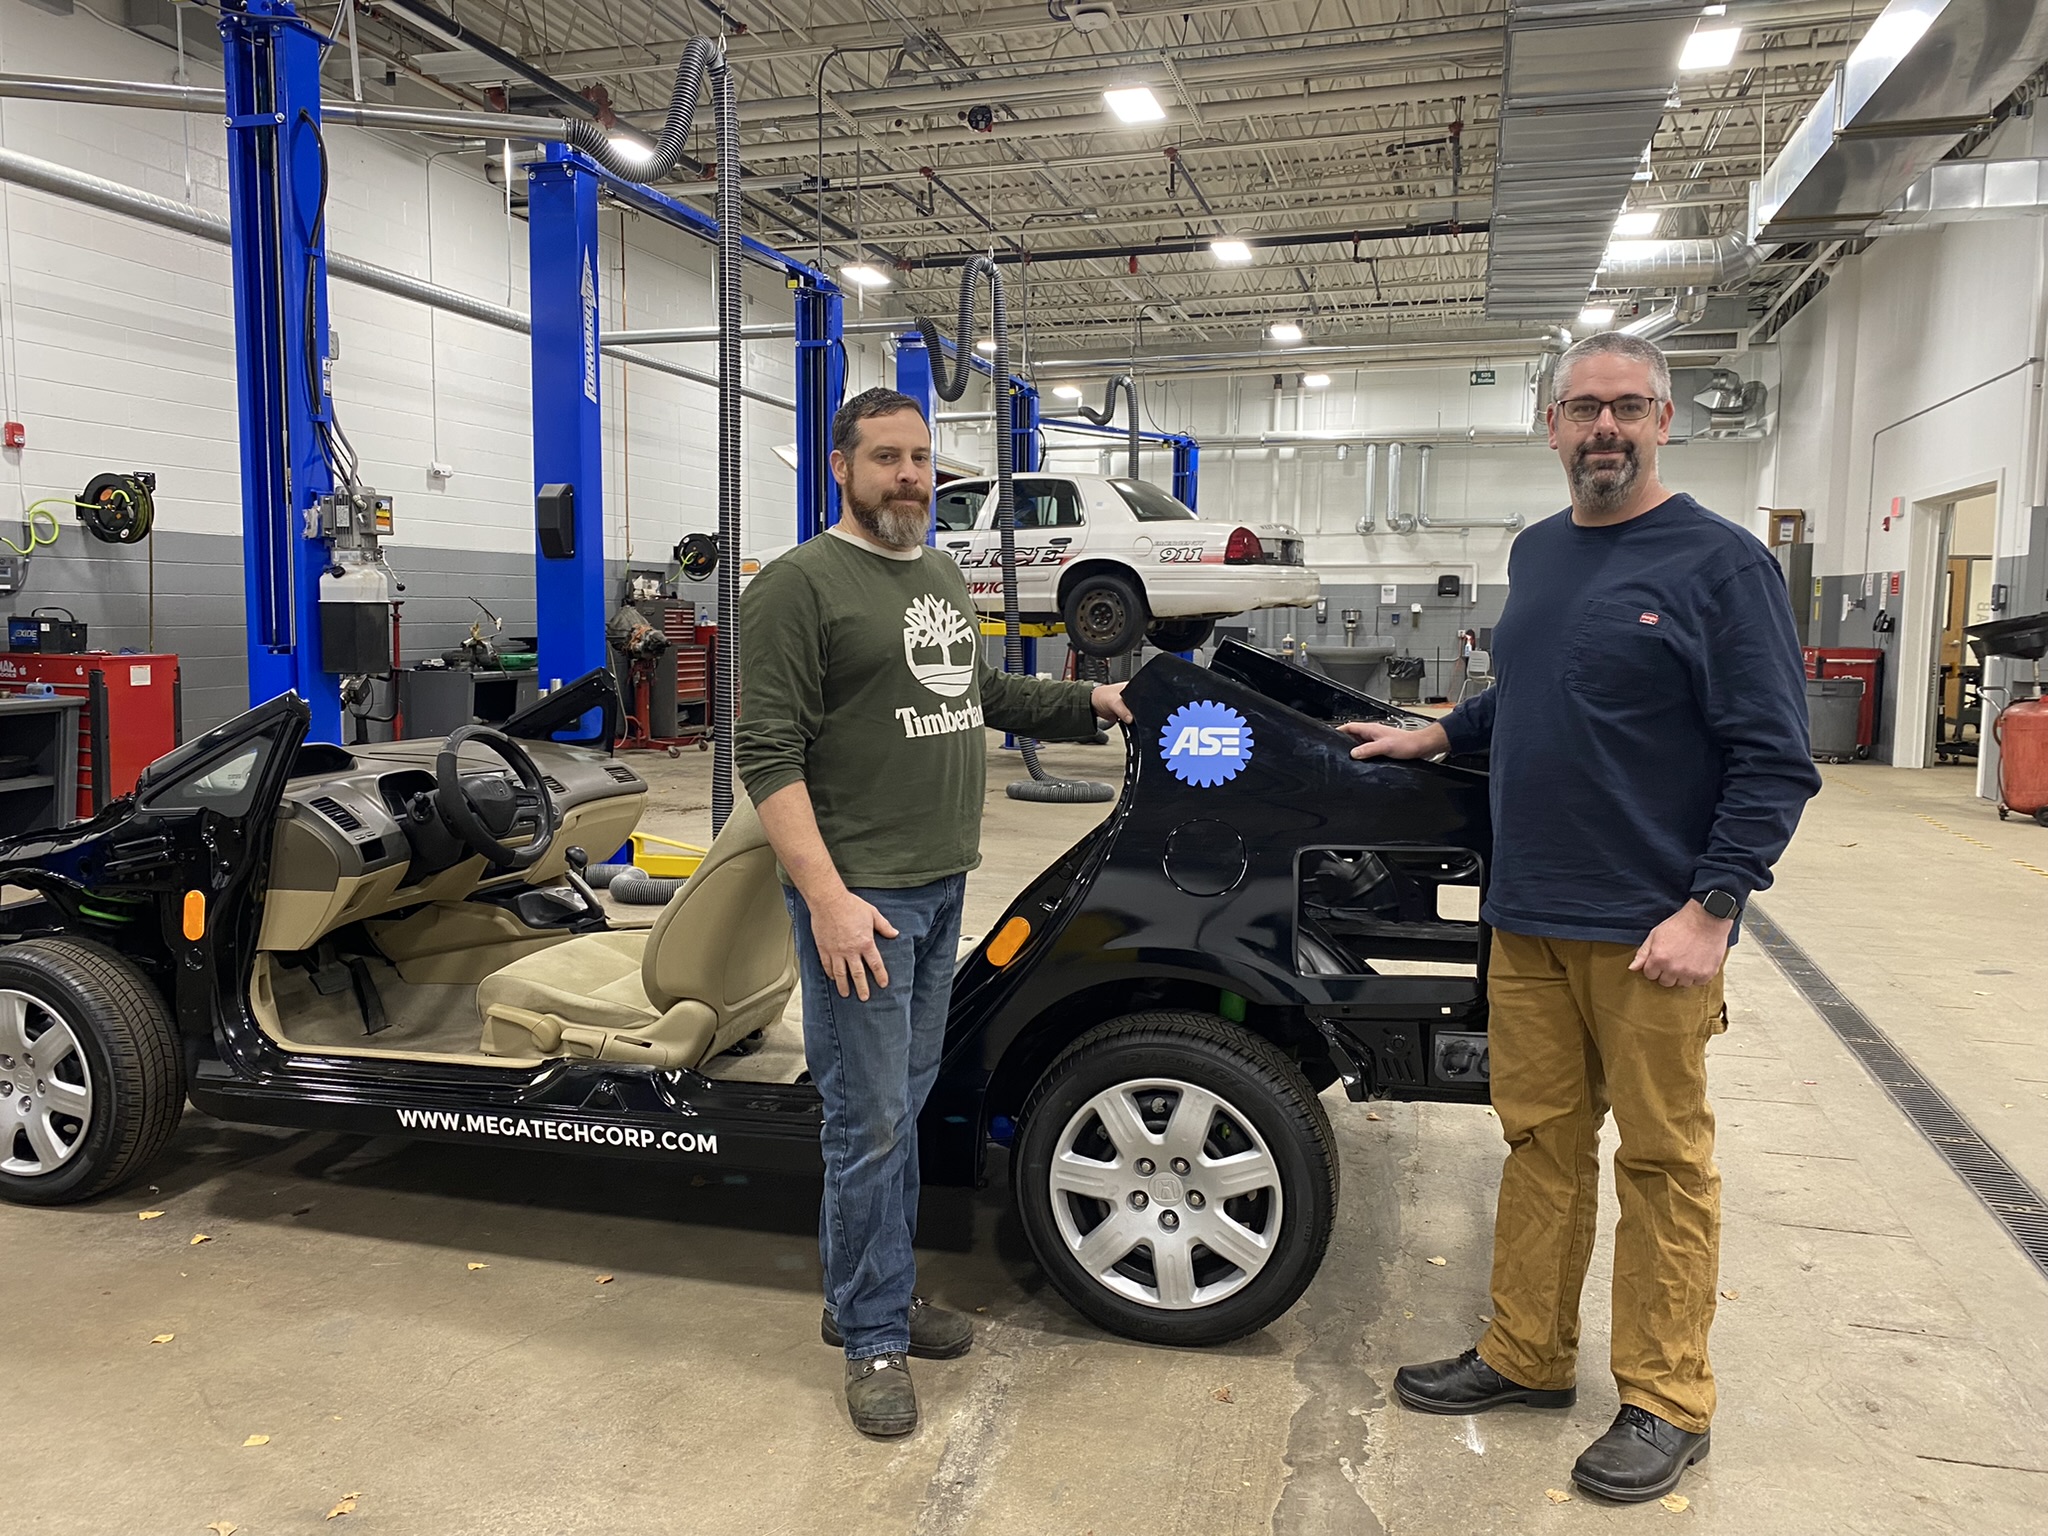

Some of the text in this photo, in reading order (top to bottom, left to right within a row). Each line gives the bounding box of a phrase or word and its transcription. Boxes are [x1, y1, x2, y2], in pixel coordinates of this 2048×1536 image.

[941, 546, 1068, 568] LICE
[1160, 547, 1204, 563] 911
[1169, 726, 1240, 756] ASE
[396, 1108, 718, 1154] WWW.MEGATECHCORP.COM
